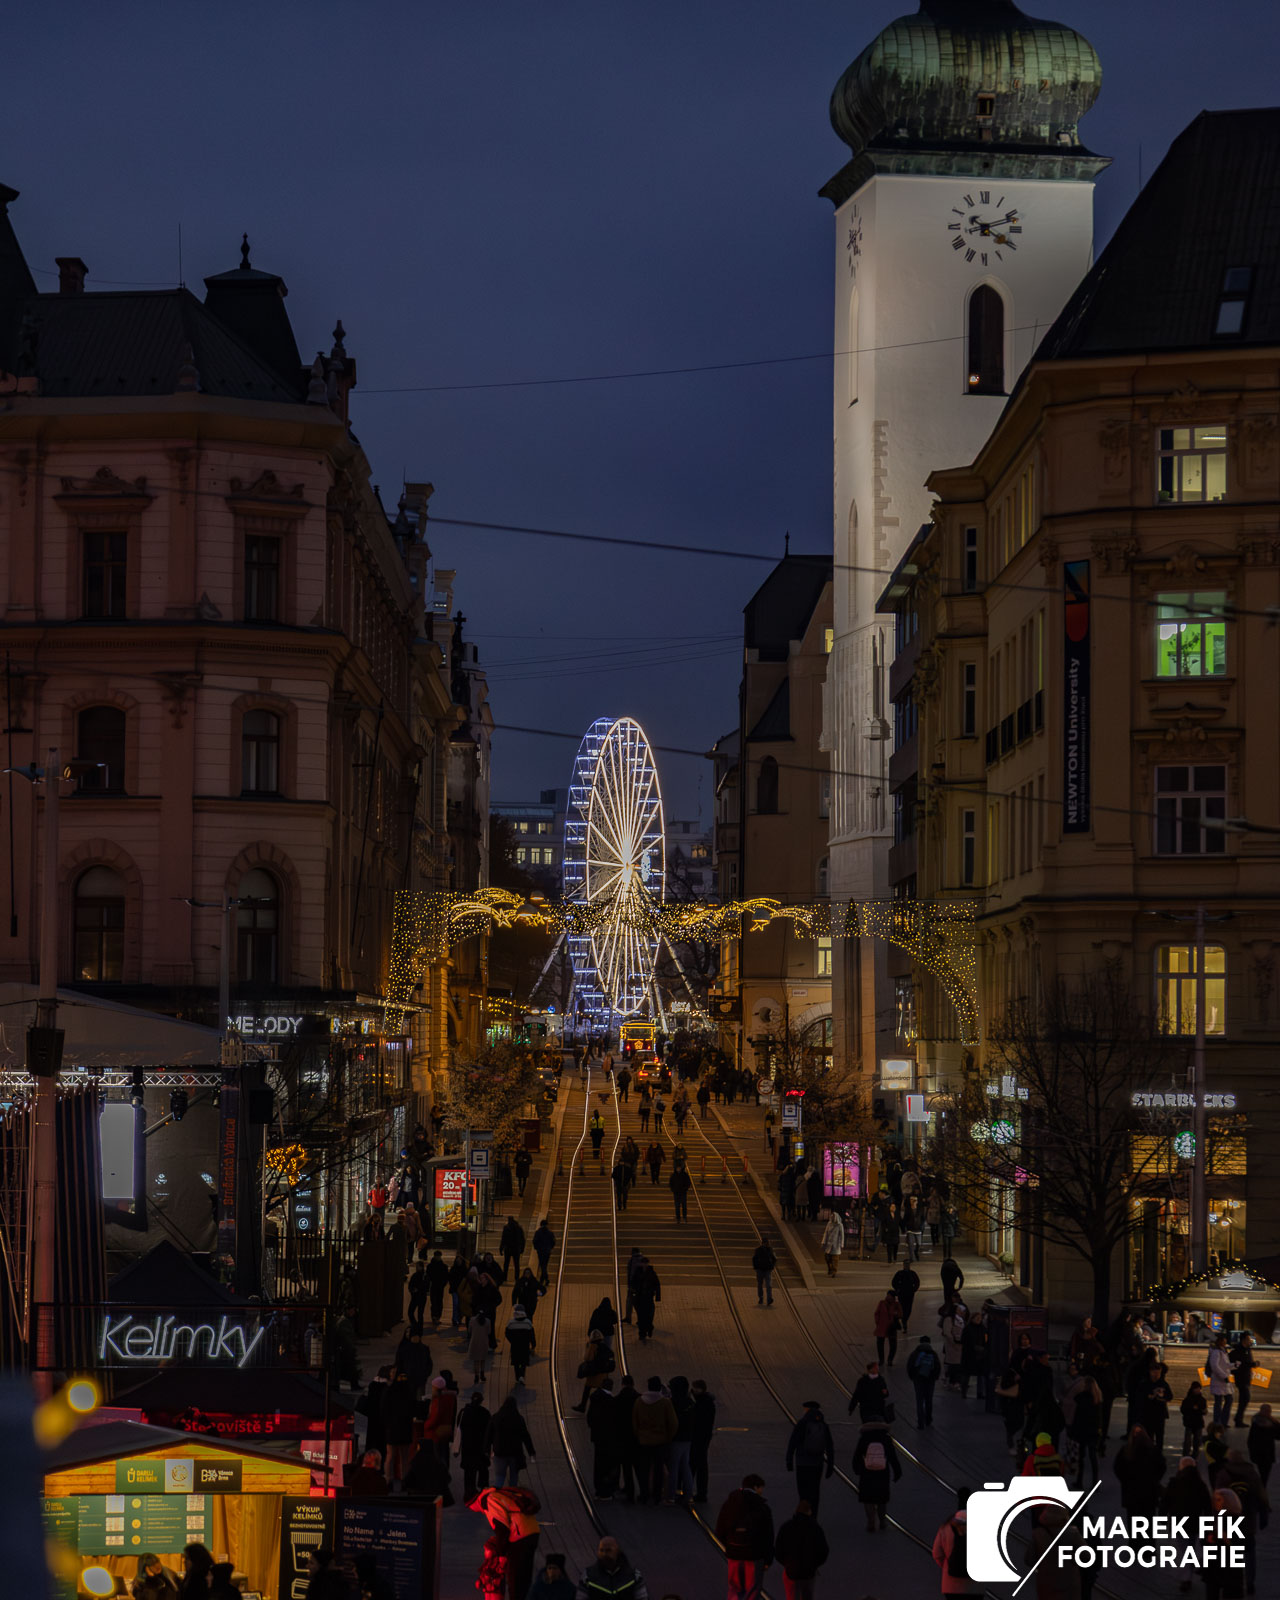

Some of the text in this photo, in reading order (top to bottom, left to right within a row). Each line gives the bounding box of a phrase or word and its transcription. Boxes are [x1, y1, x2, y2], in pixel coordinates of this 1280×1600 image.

[1067, 657, 1080, 824] NEWTON University
[100, 1315, 265, 1368] Kelímky
[264, 1421, 274, 1433] 5
[296, 1505, 321, 1513] VÝKUP
[292, 1512, 323, 1521] KELÍMKŮ
